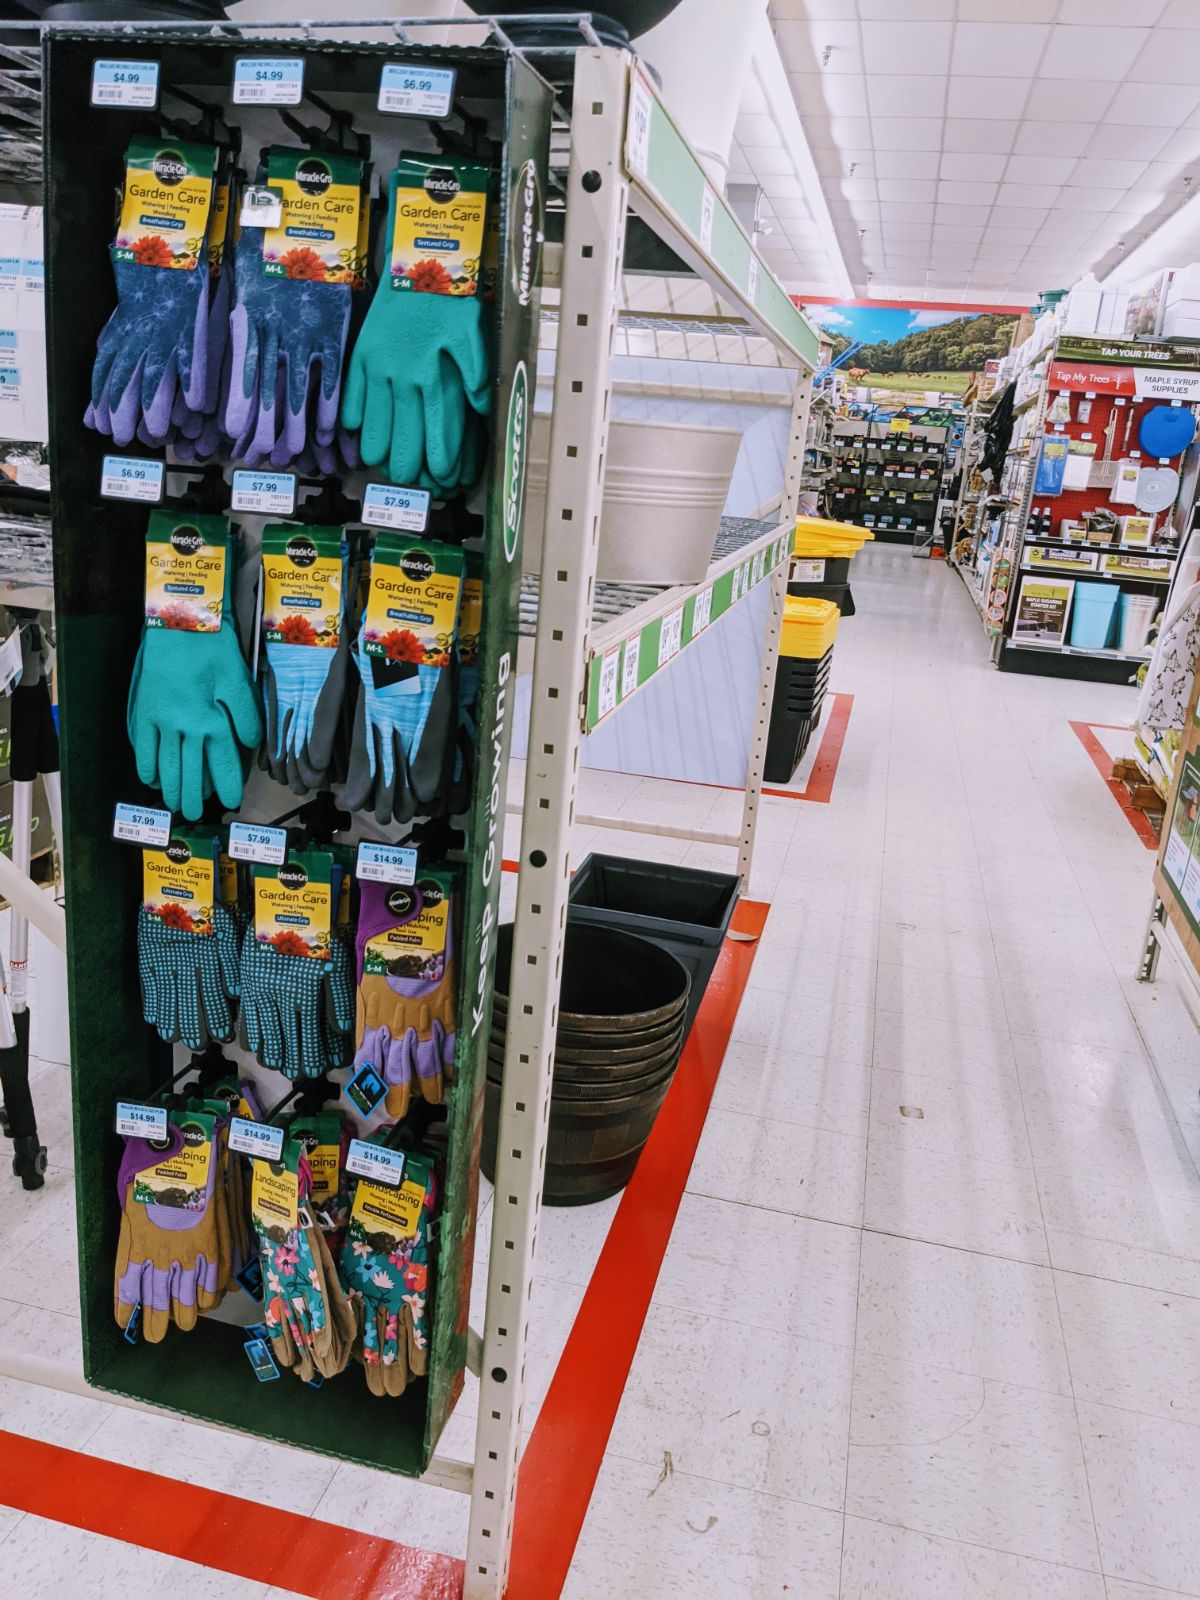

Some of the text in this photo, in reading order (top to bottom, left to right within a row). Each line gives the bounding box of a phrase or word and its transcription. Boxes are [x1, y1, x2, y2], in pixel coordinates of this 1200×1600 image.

[113, 72, 140, 84] $4.99
[255, 71, 283, 81] $4.99
[403, 78, 432, 91] $6.99
[129, 184, 206, 206] Garden Care
[141, 200, 190, 213] Watering Feeding
[282, 198, 354, 214] arden Care
[152, 209, 176, 218] Weeding
[285, 211, 338, 223] Watering Feeding
[400, 204, 480, 222] Garden Care
[141, 216, 184, 228] Breathable Grip
[299, 220, 324, 229] Weeding
[413, 221, 464, 232] Watering Feeding
[288, 228, 333, 239] Breathable Grip
[426, 230, 450, 238] Weeding
[417, 239, 454, 249] Textured Grip
[116, 251, 134, 261] S-M
[265, 265, 283, 274] M-L
[393, 278, 410, 288] S-M
[1101, 347, 1170, 360] TAP YOUR TREES
[1056, 371, 1110, 384] Tap My Trees
[1144, 375, 1199, 386] MAPLE SYRUP
[1151, 384, 1188, 394] SUPPLIES
[507, 391, 523, 533] Scotts
[121, 468, 146, 480] $6.99
[251, 482, 277, 493] $7.99
[384, 496, 410, 509] $7.99
[150, 556, 222, 571] Garden Care
[188, 571, 208, 579] Feeding
[268, 568, 308, 581] Garden
[167, 584, 188, 592] Textured
[280, 582, 302, 590] Watering
[374, 578, 454, 601] Garden Care
[282, 597, 320, 607] Breathable Grip
[387, 594, 438, 608] Watering Feeding
[461, 593, 479, 601] are
[400, 604, 424, 613] Weeding
[389, 609, 432, 623] Breathable Grip
[148, 618, 162, 627] M-L
[266, 632, 281, 640] S-M
[366, 643, 383, 653] M-L
[131, 814, 155, 826] $7.99
[247, 833, 271, 845] $7.99
[471, 651, 511, 1037] Keep Growing
[373, 853, 403, 865] $14.99
[146, 861, 210, 880] Garden Care
[158, 874, 199, 886] Watering Feeding
[163, 887, 182, 896] Ultimate
[259, 888, 328, 905] Garden Care
[296, 904, 315, 912] Feeding
[147, 914, 161, 922] S-M
[298, 917, 308, 925] Grip
[260, 943, 275, 951] M-L
[366, 964, 382, 972] S-M
[130, 1111, 155, 1123] $14.99
[243, 1127, 271, 1141] $14.99
[363, 1151, 391, 1165] $14.99
[255, 1171, 296, 1197] Landscaping
[350, 1229, 362, 1239] M-L
